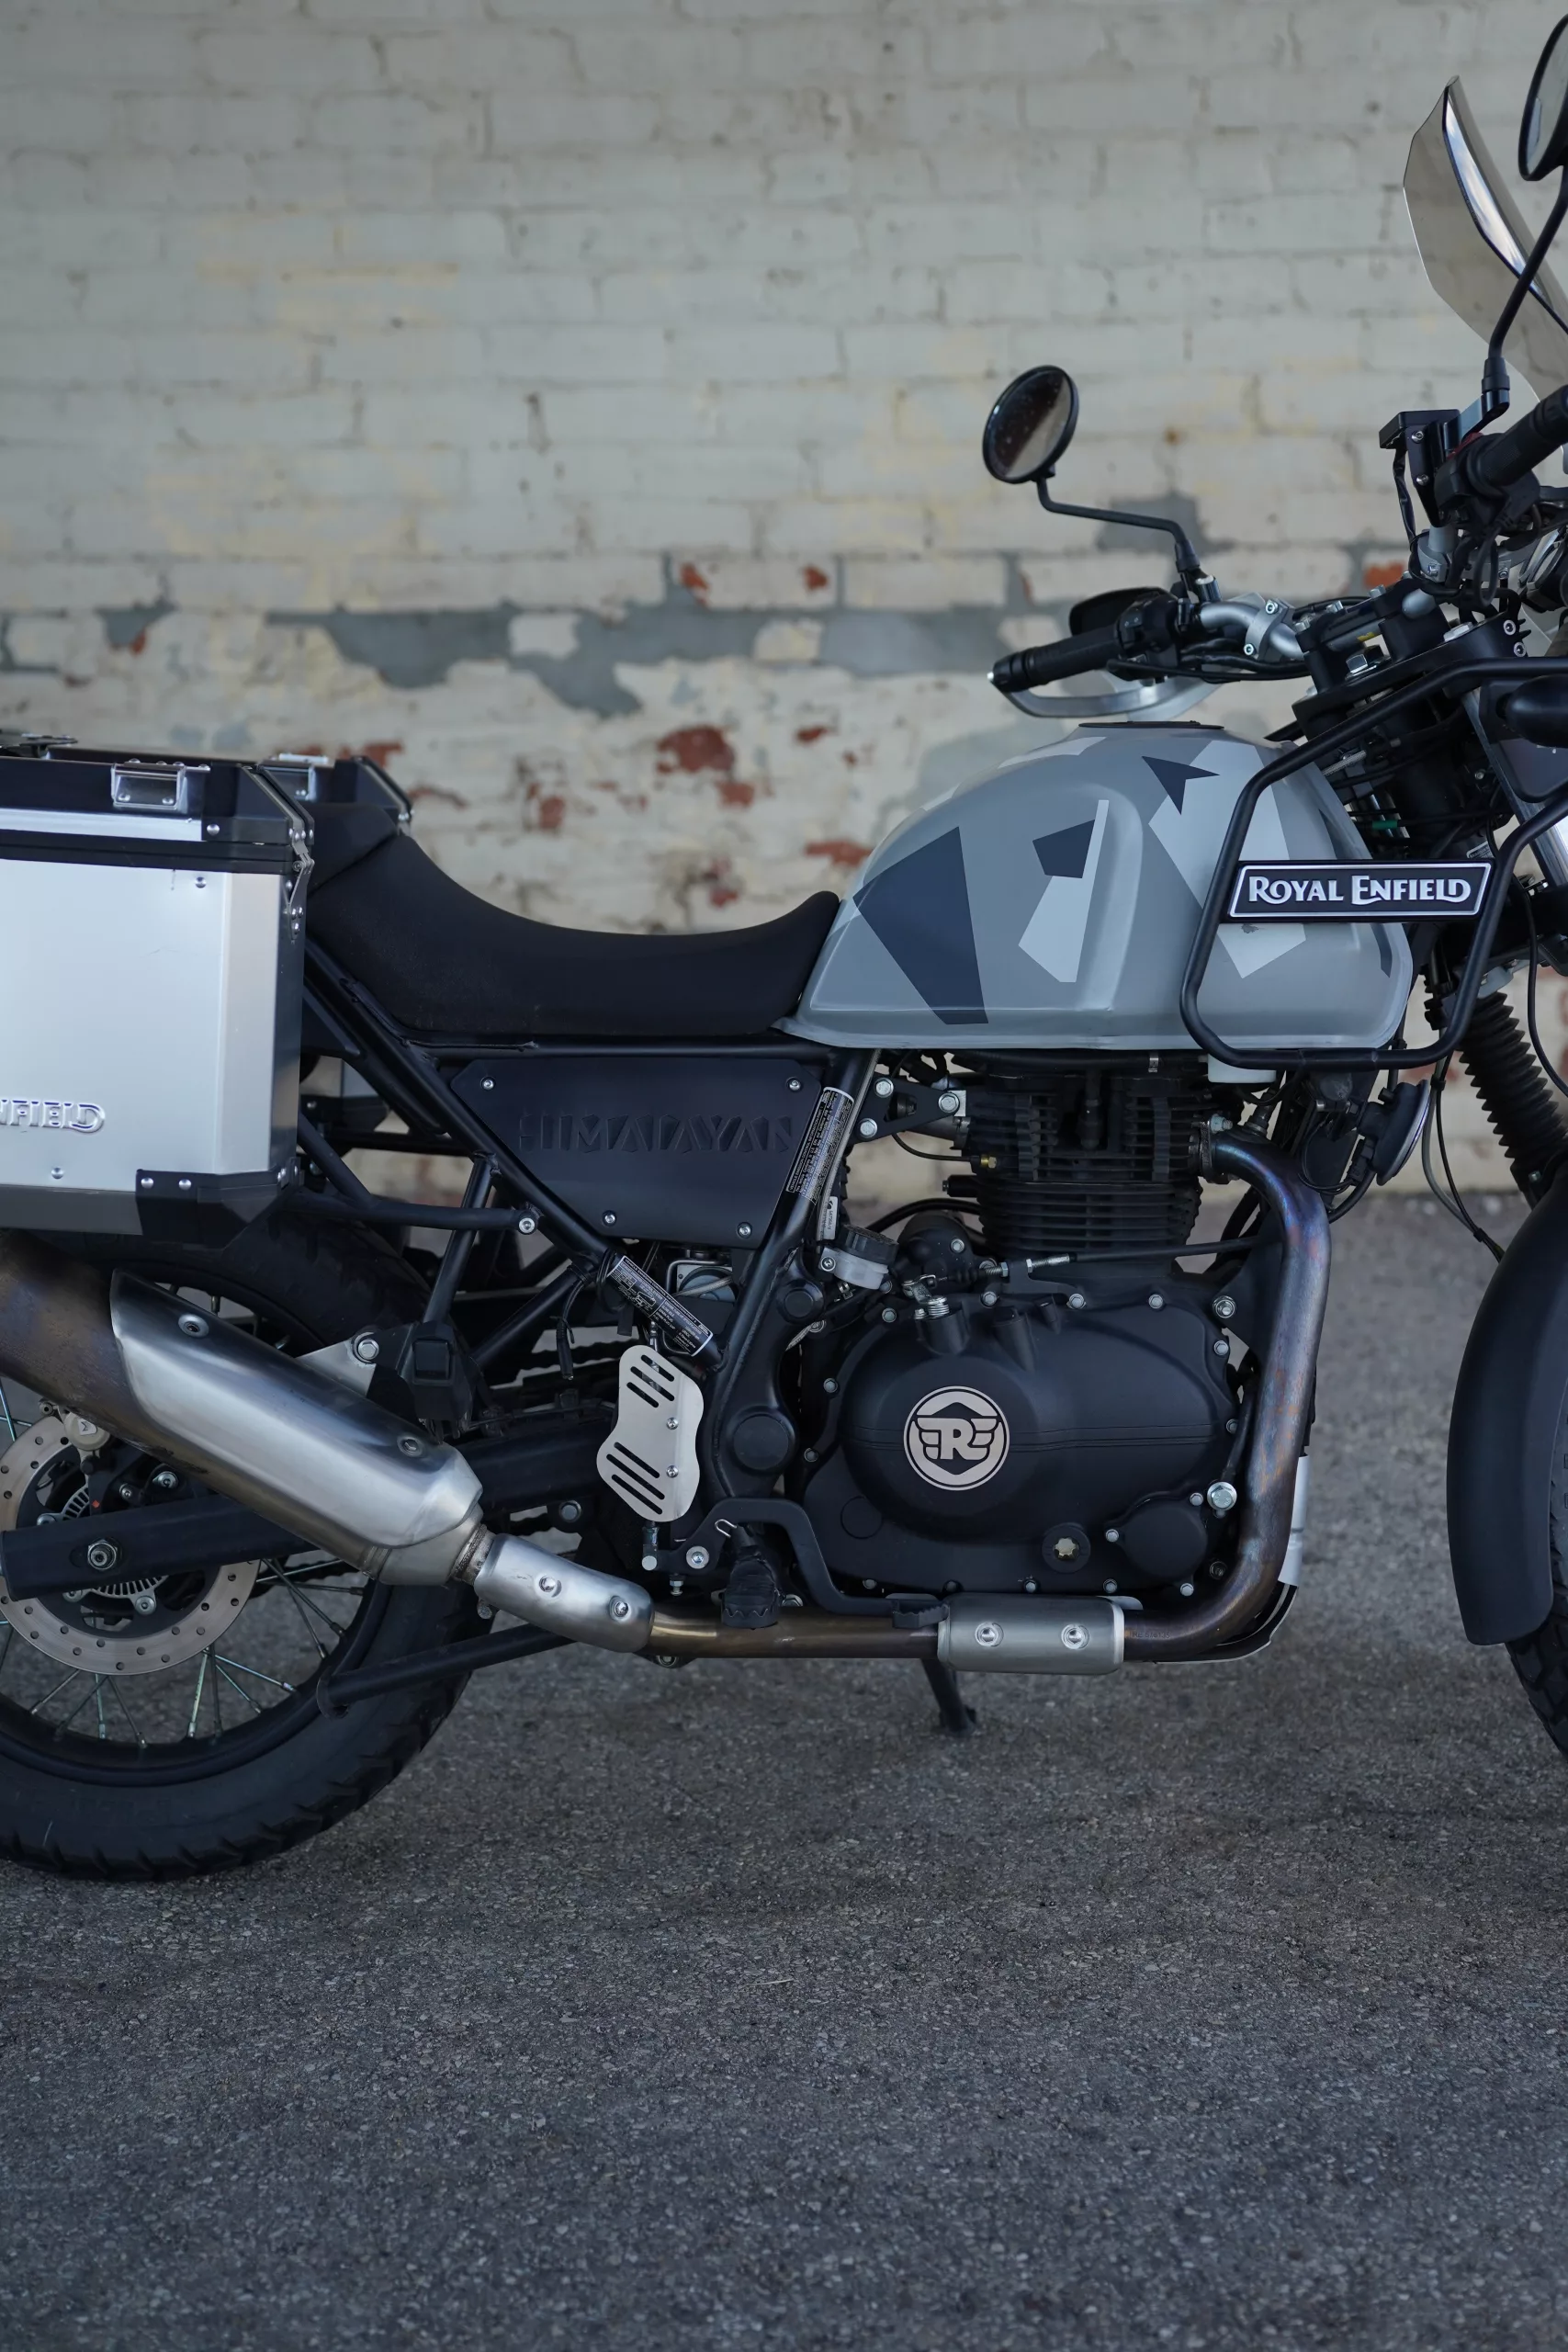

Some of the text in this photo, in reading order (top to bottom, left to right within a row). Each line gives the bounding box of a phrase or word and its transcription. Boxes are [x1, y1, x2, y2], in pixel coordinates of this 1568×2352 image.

[1248, 875, 1472, 906] ROYAL ENFIELD
[513, 1113, 798, 1154] HIMALAYAN
